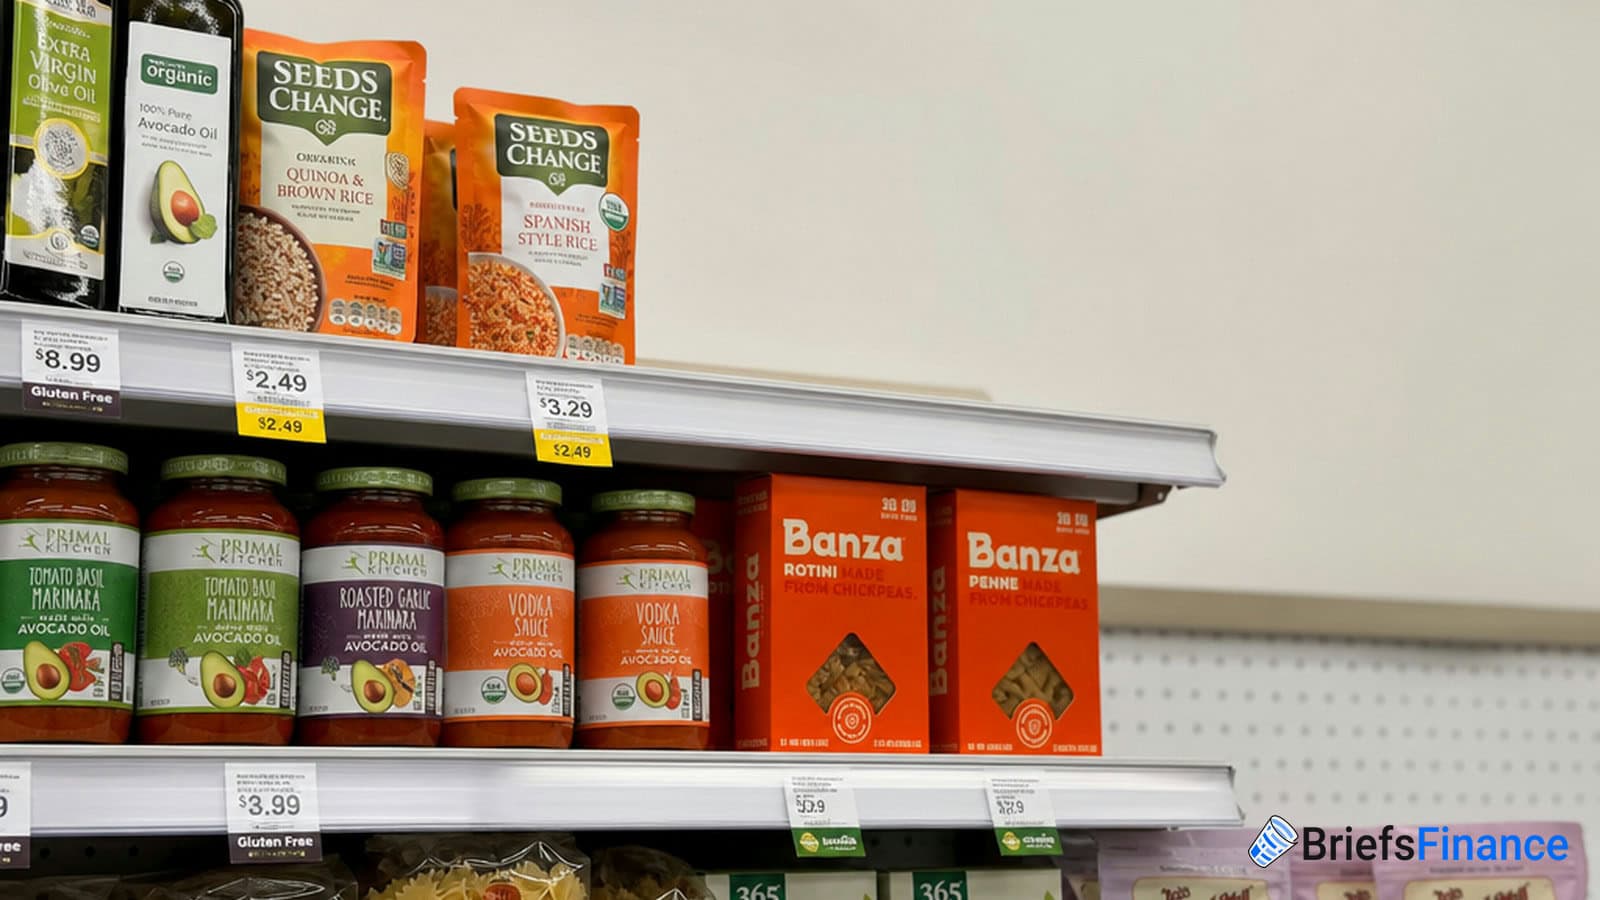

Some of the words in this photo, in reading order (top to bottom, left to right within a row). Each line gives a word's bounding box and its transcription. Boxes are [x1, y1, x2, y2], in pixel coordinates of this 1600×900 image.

[38, 33, 91, 63] EXTRA
[30, 50, 97, 85] VIRGIN
[147, 65, 213, 87] organic
[273, 60, 378, 94] SEEDS
[28, 73, 69, 97] Olive
[74, 84, 97, 104] Oil
[138, 117, 196, 137] Avocado
[200, 124, 218, 140] Oil
[509, 122, 598, 150] SEEDS
[286, 167, 348, 185] QUINOA
[353, 174, 364, 187] &
[277, 184, 336, 202] BROWN
[340, 190, 374, 206] RICE
[524, 214, 591, 234] SPANISH
[518, 232, 563, 247] STYLE
[566, 236, 598, 252] RICE
[35, 348, 101, 373] $8.99
[246, 369, 307, 392] $2.49
[31, 385, 79, 401] Gluten
[83, 390, 113, 404] Free
[539, 397, 593, 418] $3.29
[258, 416, 303, 433] $2.49
[46, 528, 111, 545] PRIMAL
[783, 518, 903, 561] Banza
[45, 544, 111, 556] KITCHEN
[221, 539, 281, 556] PRIMAL
[967, 531, 1080, 575] Banza
[220, 554, 282, 567] KITCHEN
[368, 551, 427, 567] PRIMAL
[513, 557, 561, 573] PRIMAL
[29, 567, 72, 586] TOMATO
[76, 568, 104, 589] BASIL
[639, 568, 690, 582] PRIMAL
[784, 563, 838, 579] ROTINI
[842, 568, 885, 582] MADE
[969, 575, 1019, 590] PENNE
[204, 578, 248, 597] TOMATO
[340, 586, 392, 609] ROASTED
[397, 587, 431, 610] GARLIC
[784, 581, 829, 595] FROM
[32, 588, 101, 611] MARINARA
[508, 593, 553, 617] VODKA
[636, 602, 680, 625] VODKA
[742, 552, 760, 690] Banza
[17, 622, 87, 635] AVOCADO
[90, 624, 110, 637] OIL
[192, 632, 262, 644] AVOCADO
[514, 617, 548, 638] SAUCE
[641, 625, 676, 646] SAUCE
[344, 640, 409, 652] AVOCADO
[239, 795, 300, 816] $3.99
[237, 835, 281, 849] Gluten
[285, 836, 313, 848] Free
